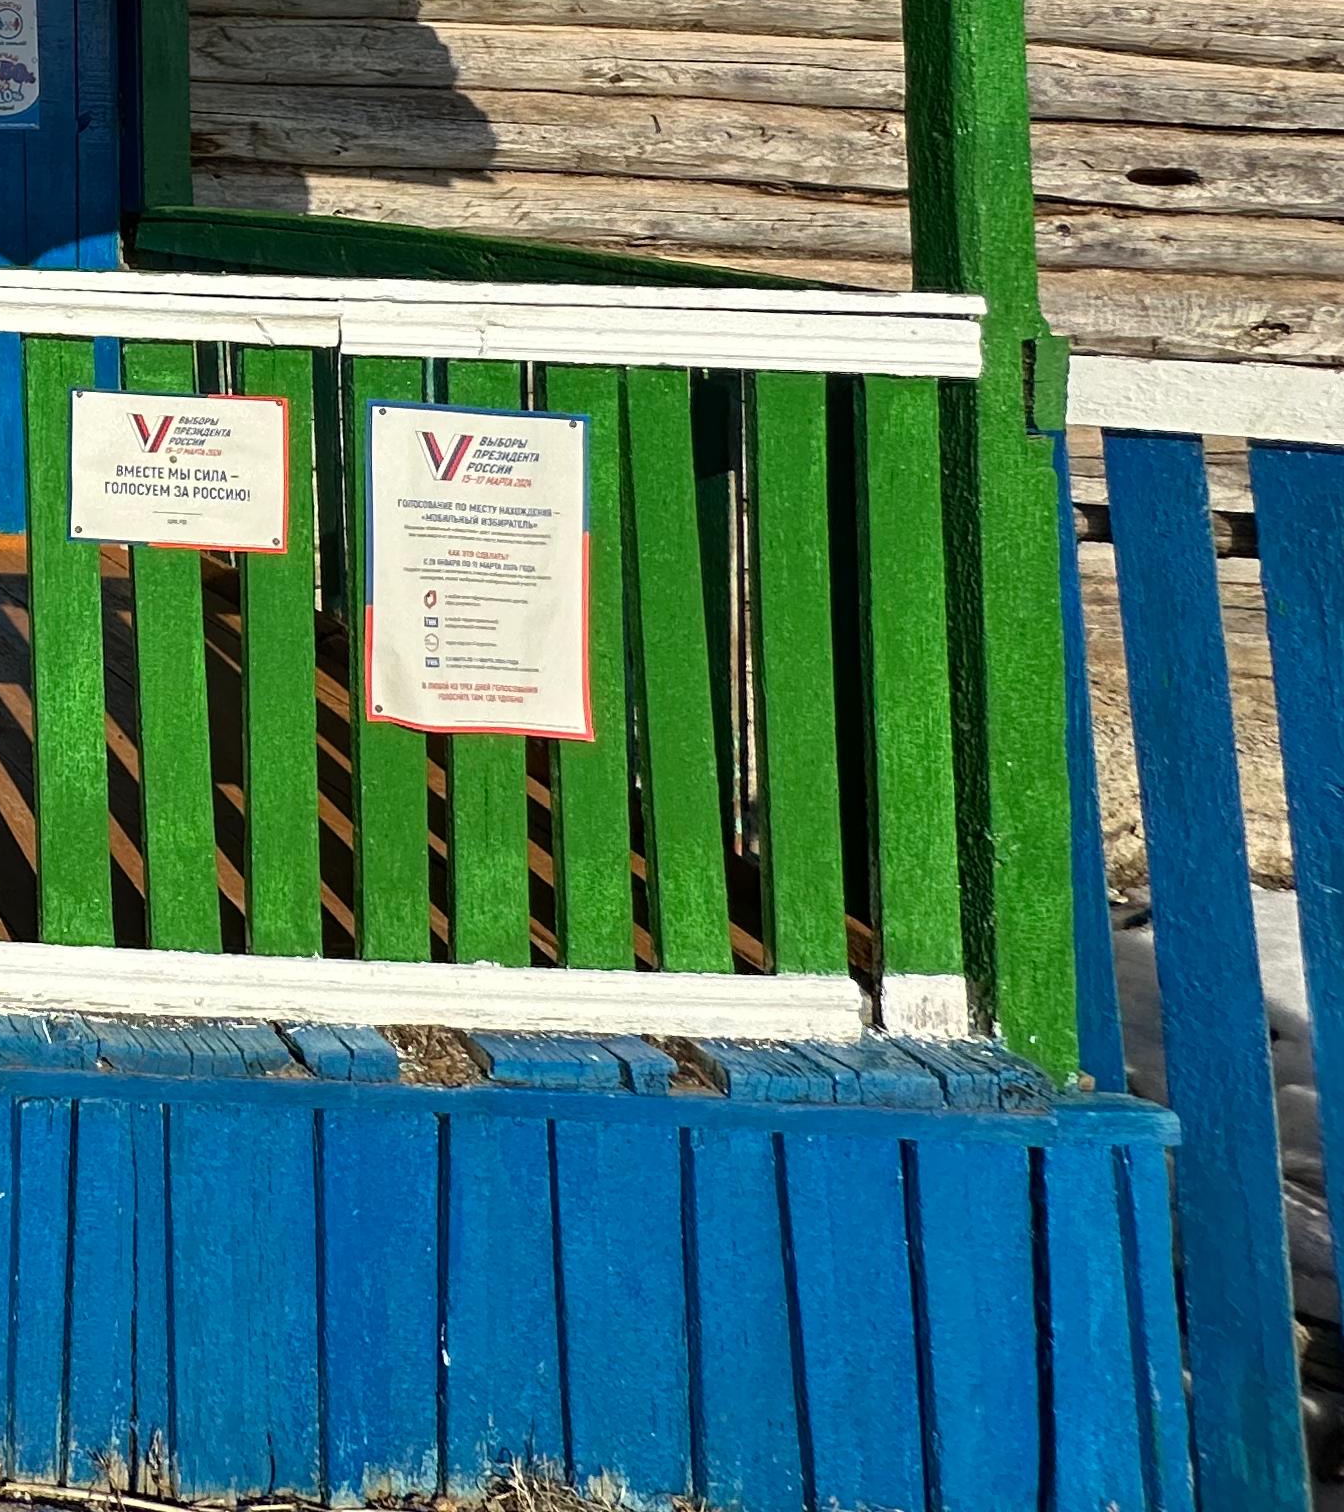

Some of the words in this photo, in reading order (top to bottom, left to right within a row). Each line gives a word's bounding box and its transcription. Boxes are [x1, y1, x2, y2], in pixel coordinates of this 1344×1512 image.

[178, 415, 219, 426] ВЫБОРЫ
[173, 426, 231, 438] ПРЕЗИДЕНТА
[168, 437, 206, 447] РОССИИ
[479, 436, 528, 449] ВЫБОРЫ
[472, 449, 540, 463] ПРЕЗИДЕНТА
[116, 465, 164, 480] ВМЕСТЕ
[168, 467, 191, 481] МЫ
[194, 469, 227, 482] СИЛА
[466, 462, 513, 475] РОССИИ
[485, 476, 513, 487] МАРТА
[104, 482, 170, 497] ГОЛОСУЕМ
[174, 485, 190, 498] ЗА
[193, 487, 250, 502] РОССИЮ!
[469, 503, 497, 514] МЕСТУ
